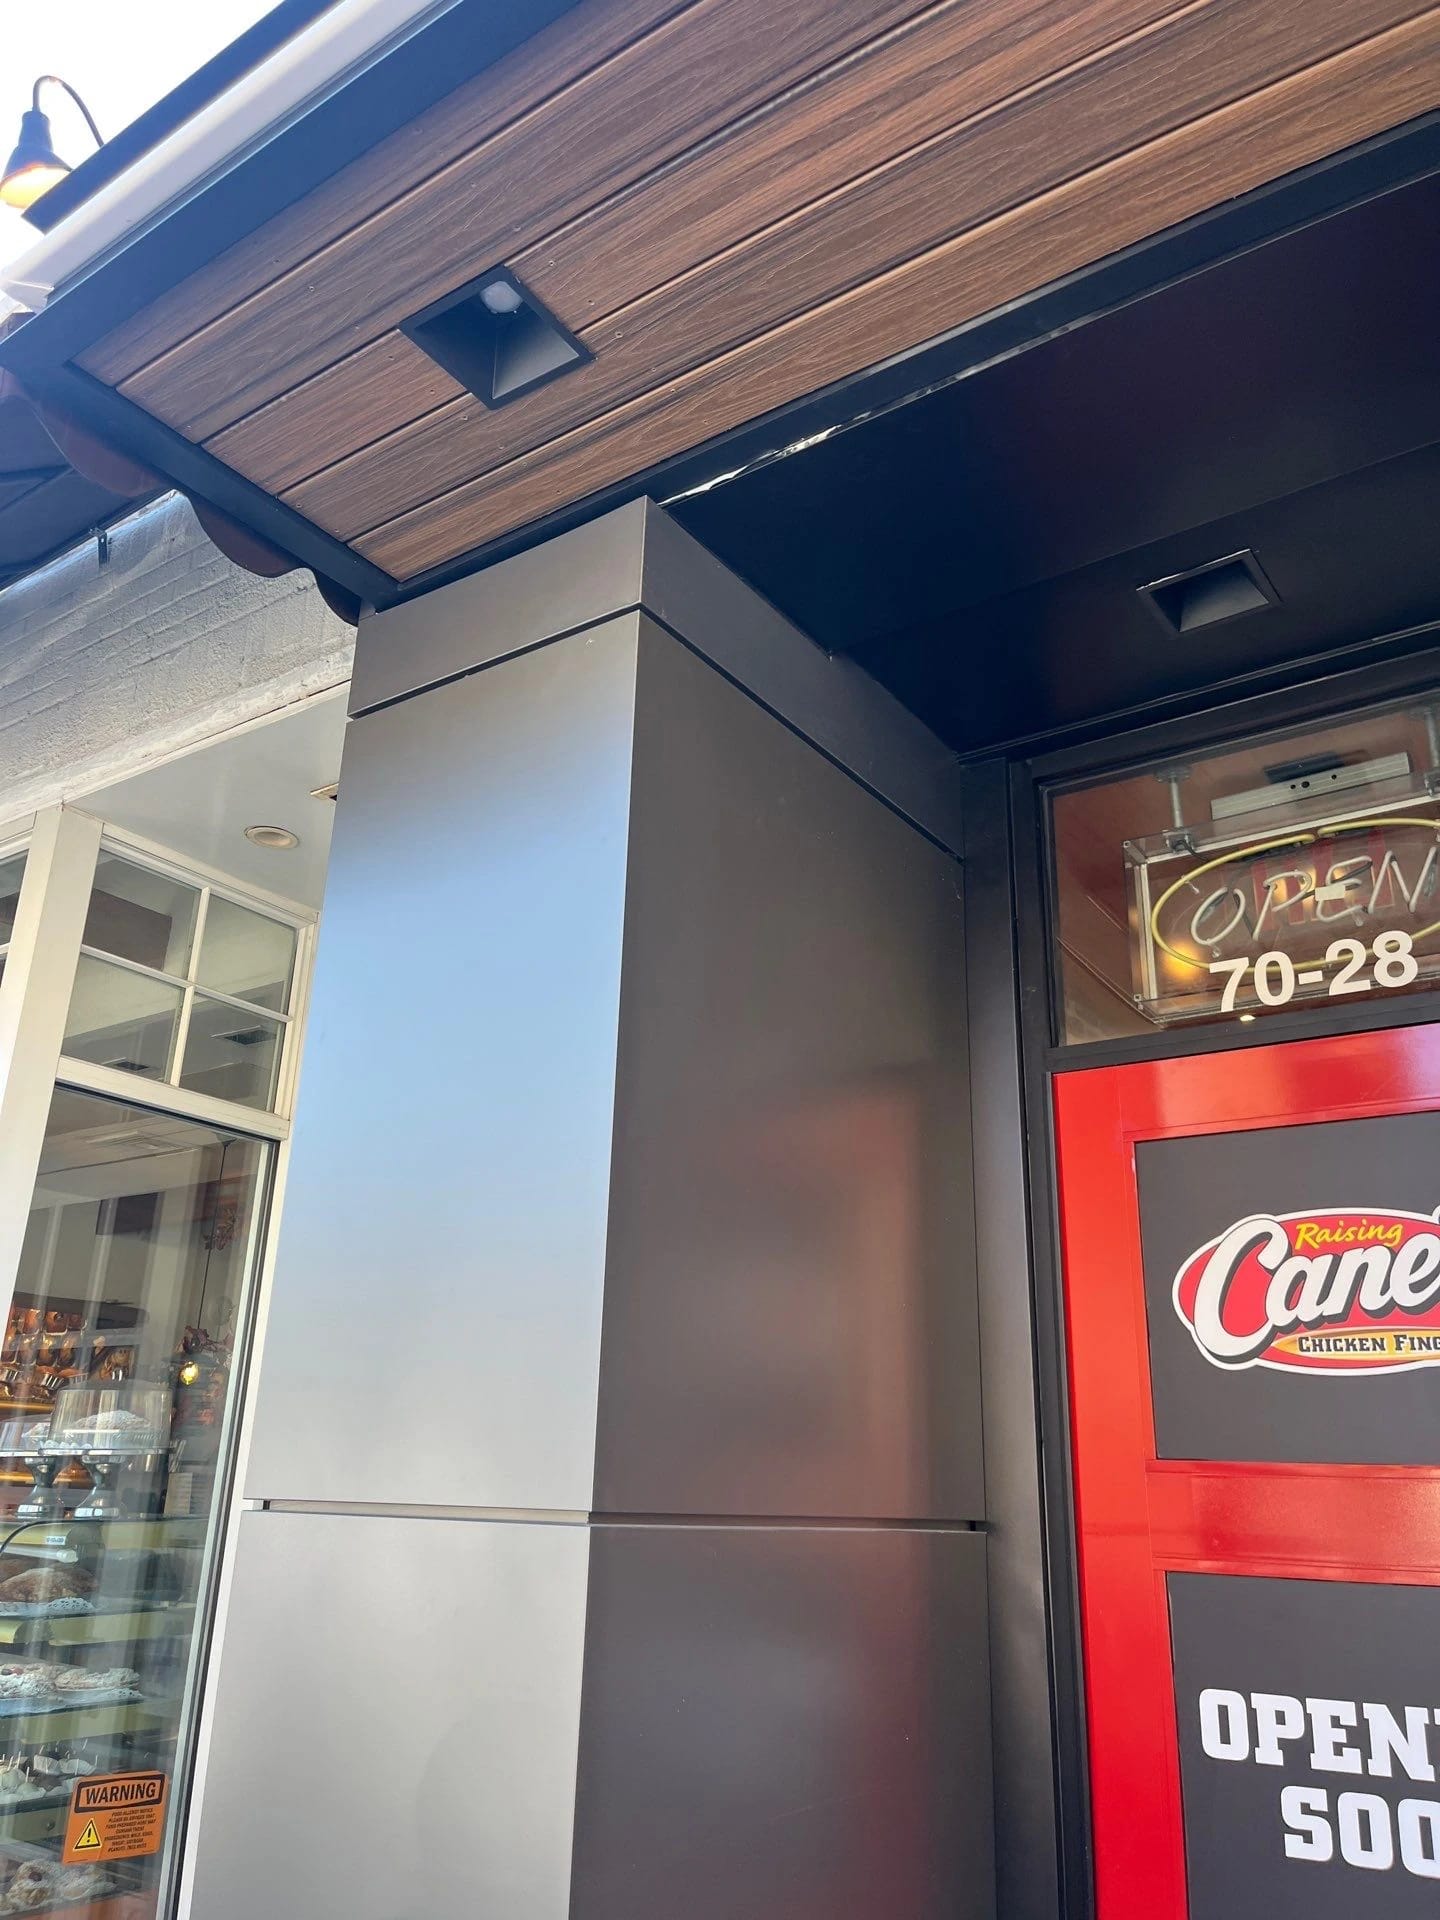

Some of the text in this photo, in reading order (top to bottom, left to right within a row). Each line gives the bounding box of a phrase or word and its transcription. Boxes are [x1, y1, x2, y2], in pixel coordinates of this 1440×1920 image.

[1190, 846, 1438, 946] OPEN
[1209, 930, 1419, 1013] 70-28
[1295, 1218, 1404, 1250] Raising
[1193, 1217, 1440, 1357] Cane
[1298, 1335, 1386, 1354] CHICKEN
[1199, 1688, 1440, 1782] OPEN
[85, 1782, 157, 1805] WARNING
[1280, 1785, 1440, 1880] SOO
